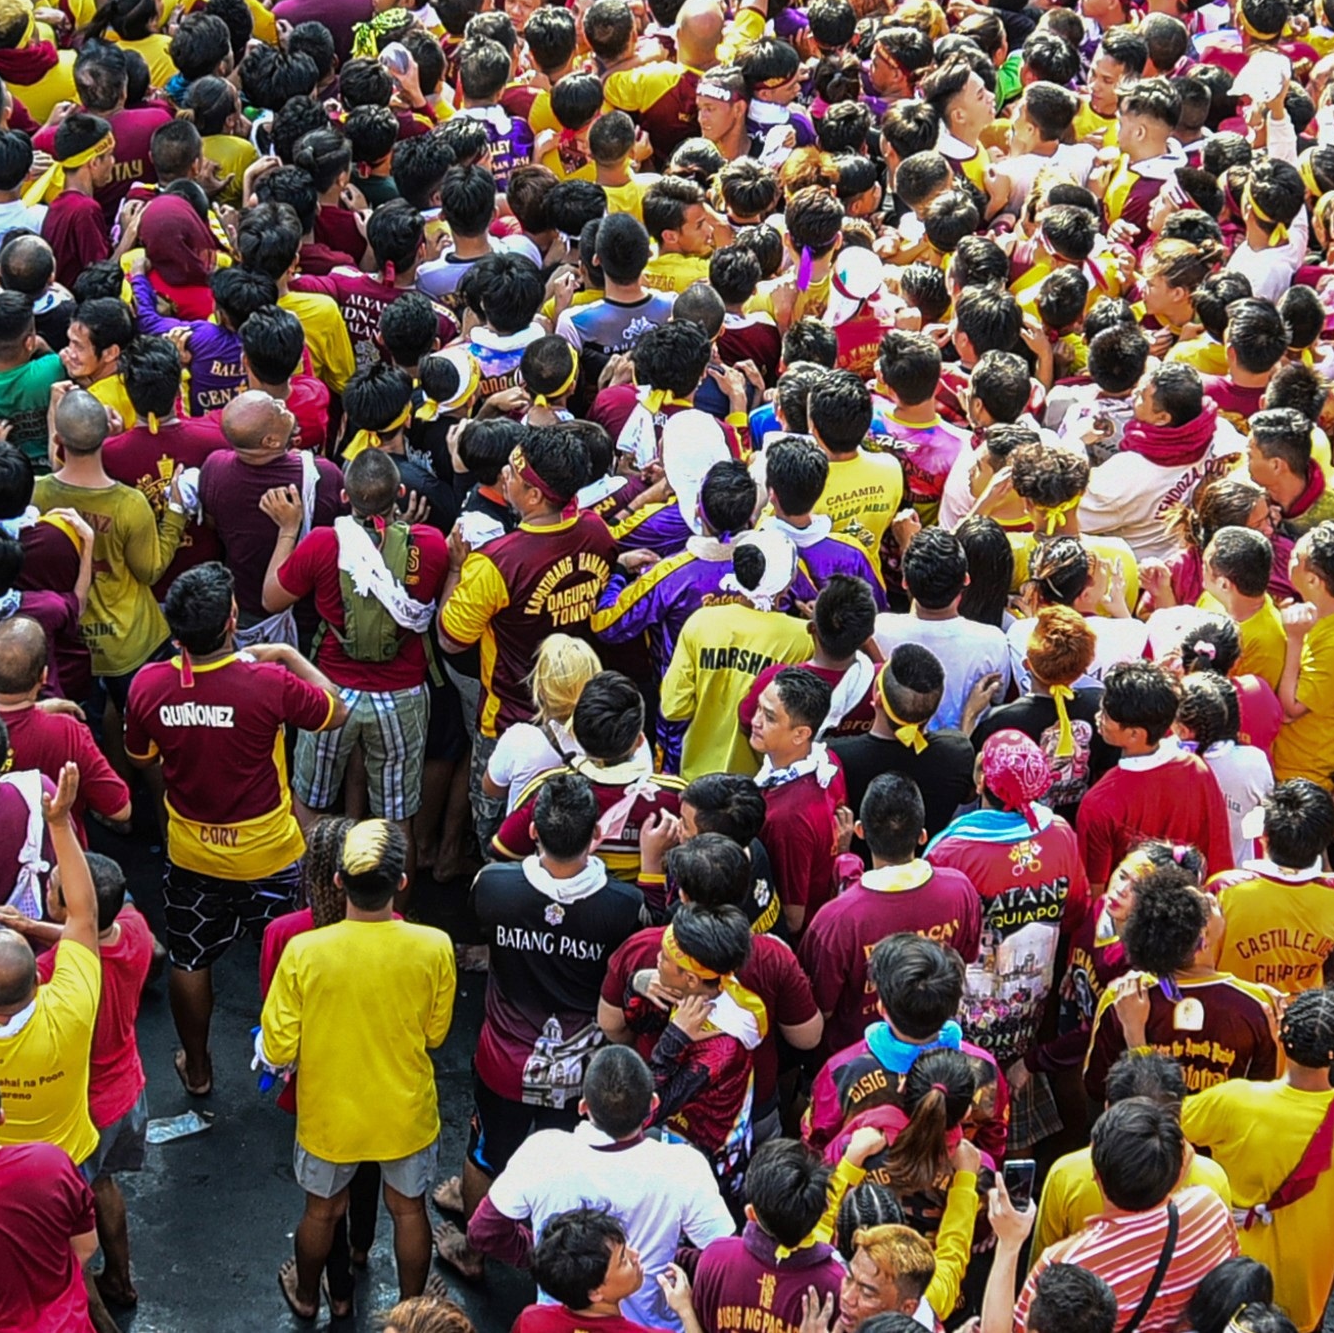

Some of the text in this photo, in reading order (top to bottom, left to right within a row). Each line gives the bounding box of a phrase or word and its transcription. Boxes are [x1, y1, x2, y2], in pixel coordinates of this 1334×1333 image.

[825, 484, 885, 507] CALAMBA
[524, 555, 574, 615] KAPATIRANG
[699, 646, 774, 676] MARSHA
[158, 700, 236, 729] QUIÑONEZ
[199, 826, 240, 848] CORY
[496, 925, 607, 964] BATANG PASAY
[23, 1078, 37, 1088] na
[39, 1069, 65, 1085] Poon
[744, 1306, 763, 1331] NG
